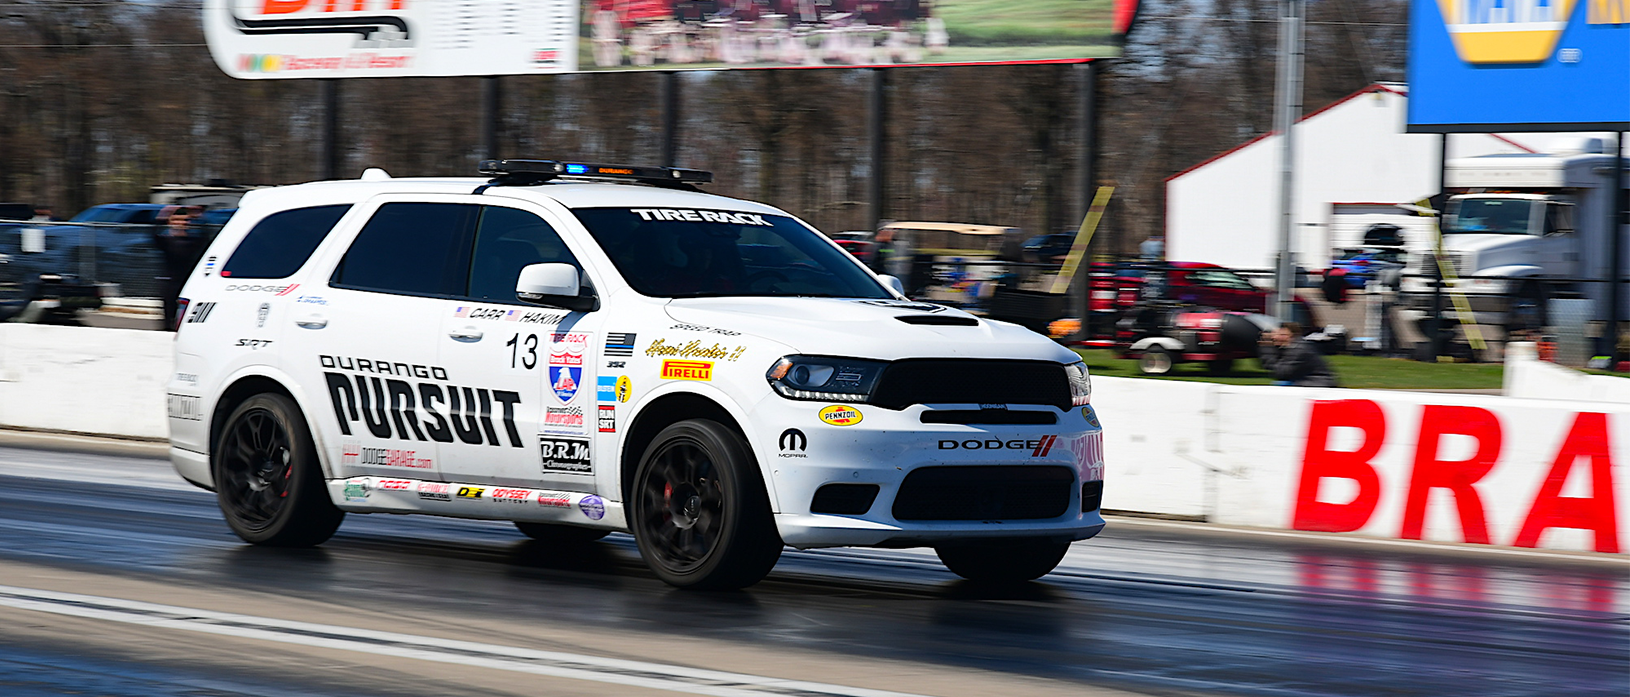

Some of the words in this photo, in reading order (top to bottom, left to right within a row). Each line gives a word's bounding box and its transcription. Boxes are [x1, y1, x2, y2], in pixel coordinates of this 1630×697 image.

[225, 284, 289, 293] DODGE
[469, 308, 506, 320] CARR
[519, 312, 567, 325] HAKIM
[669, 323, 710, 332] SPEED
[708, 328, 742, 336] TRAP
[235, 339, 273, 350] SRT
[549, 333, 567, 343] TIRE
[566, 333, 589, 348] RACK
[506, 333, 538, 370] 13
[319, 354, 449, 381] DURANGO
[662, 361, 711, 379] PIRELLI
[323, 371, 525, 448] PURSUIT
[825, 411, 857, 421] PENNZOIL
[598, 419, 614, 429] SRT
[937, 439, 1043, 450] DODGE
[1291, 398, 1622, 554] BRA
[492, 488, 532, 500] ODYSSEY
